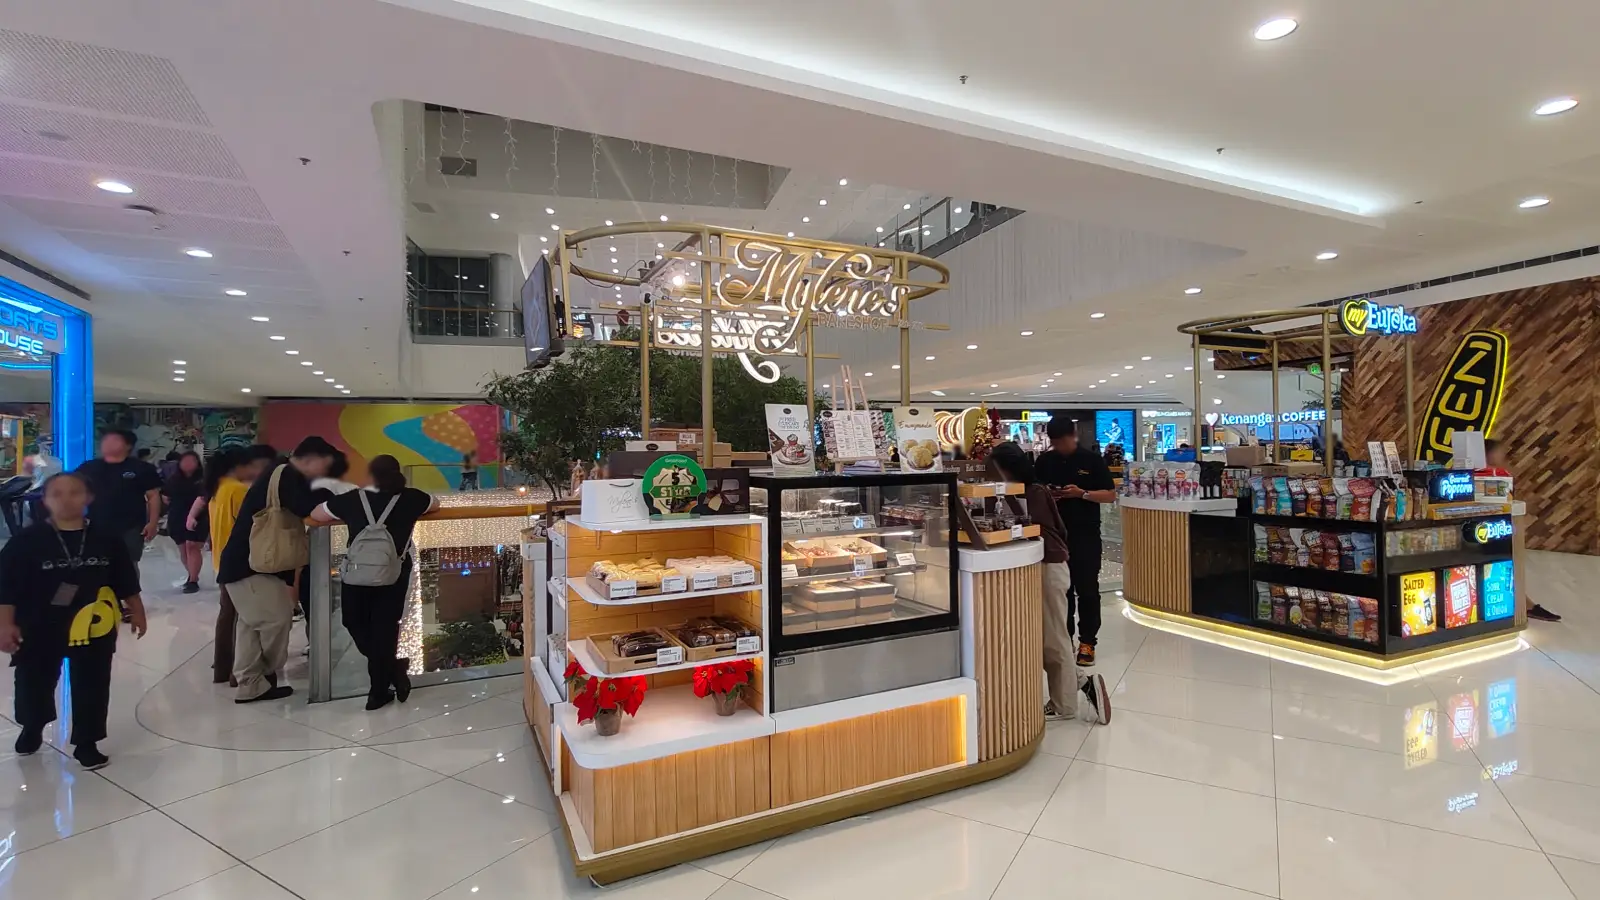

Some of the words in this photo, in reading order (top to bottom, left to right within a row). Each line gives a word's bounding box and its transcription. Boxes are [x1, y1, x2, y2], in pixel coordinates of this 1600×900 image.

[816, 311, 889, 333] BAKESHOP
[1348, 308, 1368, 328] my
[1368, 303, 1417, 334] Eureka
[1282, 410, 1326, 422] COFFEE
[672, 473, 680, 485] 5
[1442, 479, 1473, 499] Popcorn
[1487, 520, 1513, 539] Eureka
[1403, 578, 1425, 591] SALTED
[1403, 593, 1416, 605] EGG
